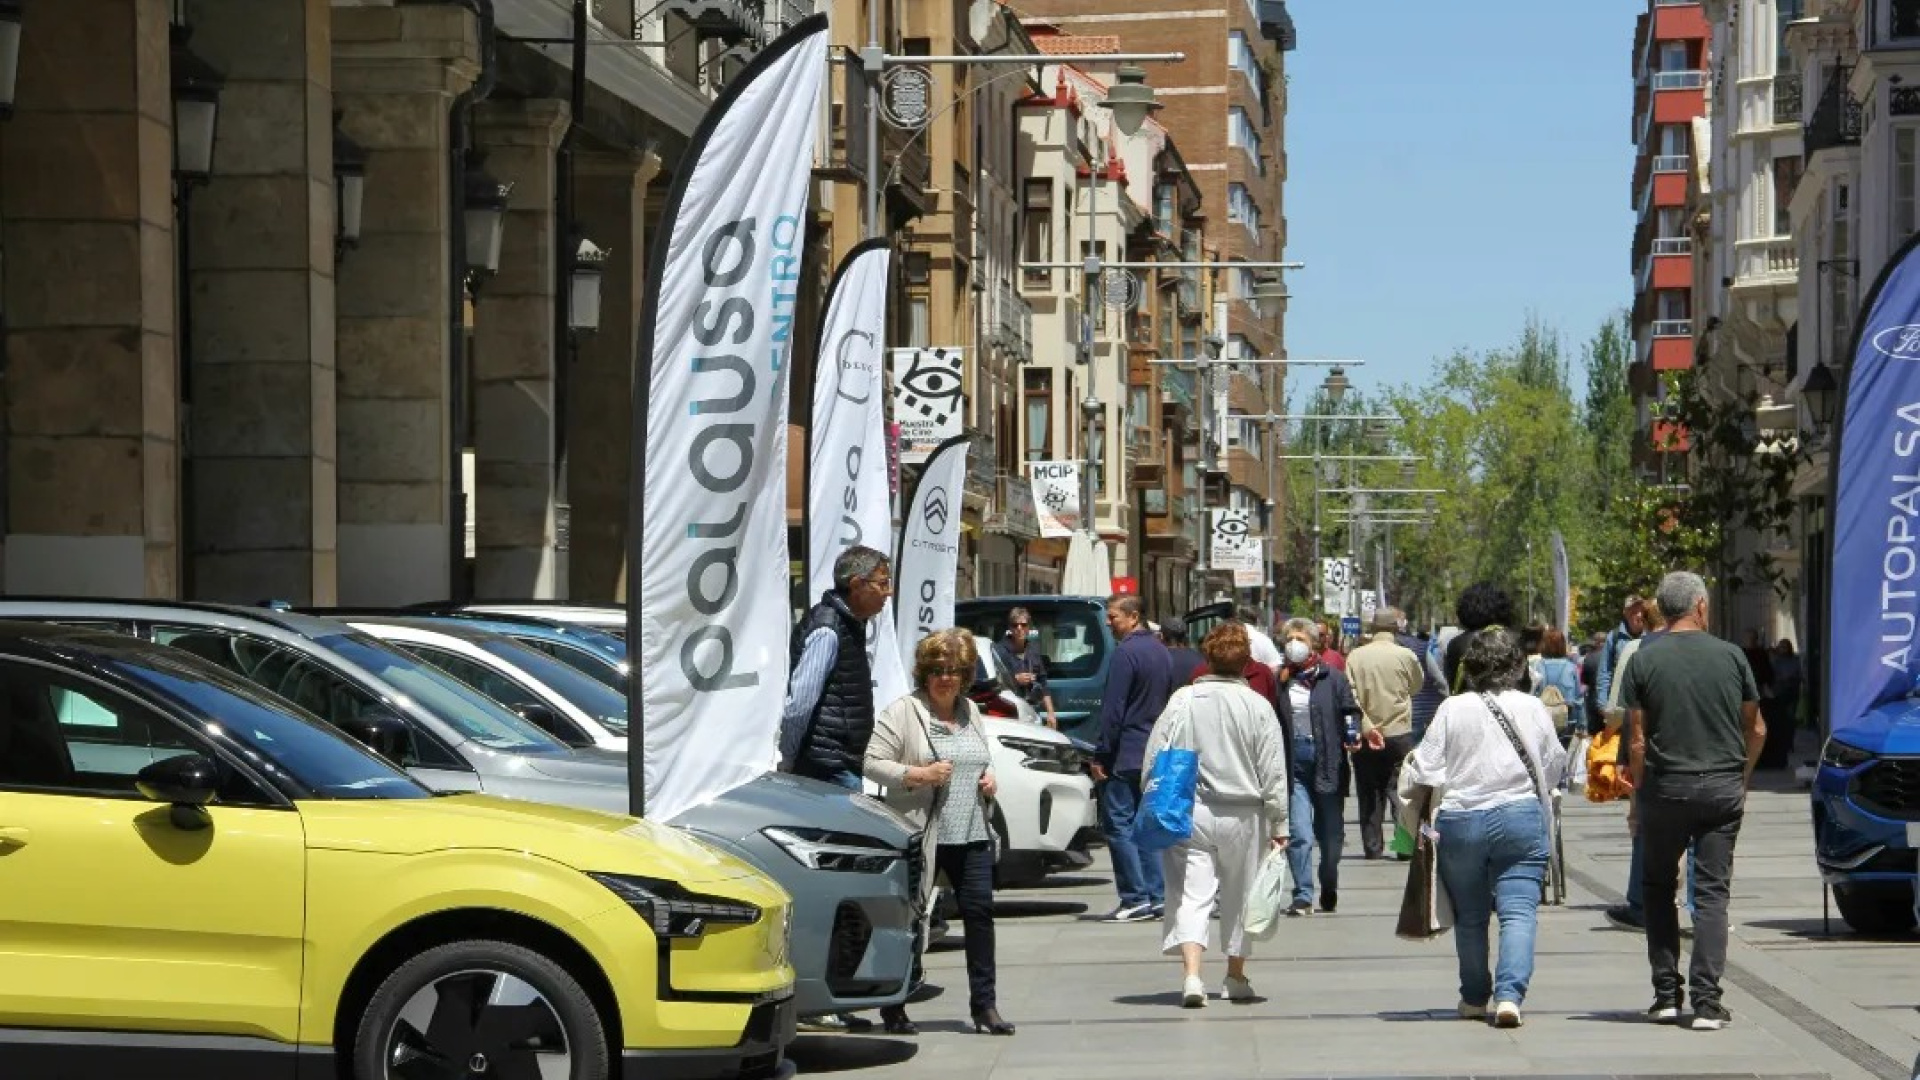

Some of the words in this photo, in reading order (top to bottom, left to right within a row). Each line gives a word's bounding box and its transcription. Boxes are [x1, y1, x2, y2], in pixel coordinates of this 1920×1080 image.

[680, 217, 759, 692] palausa
[1034, 464, 1074, 479] MCIP
[1881, 403, 1920, 673] AUTOPALSA
